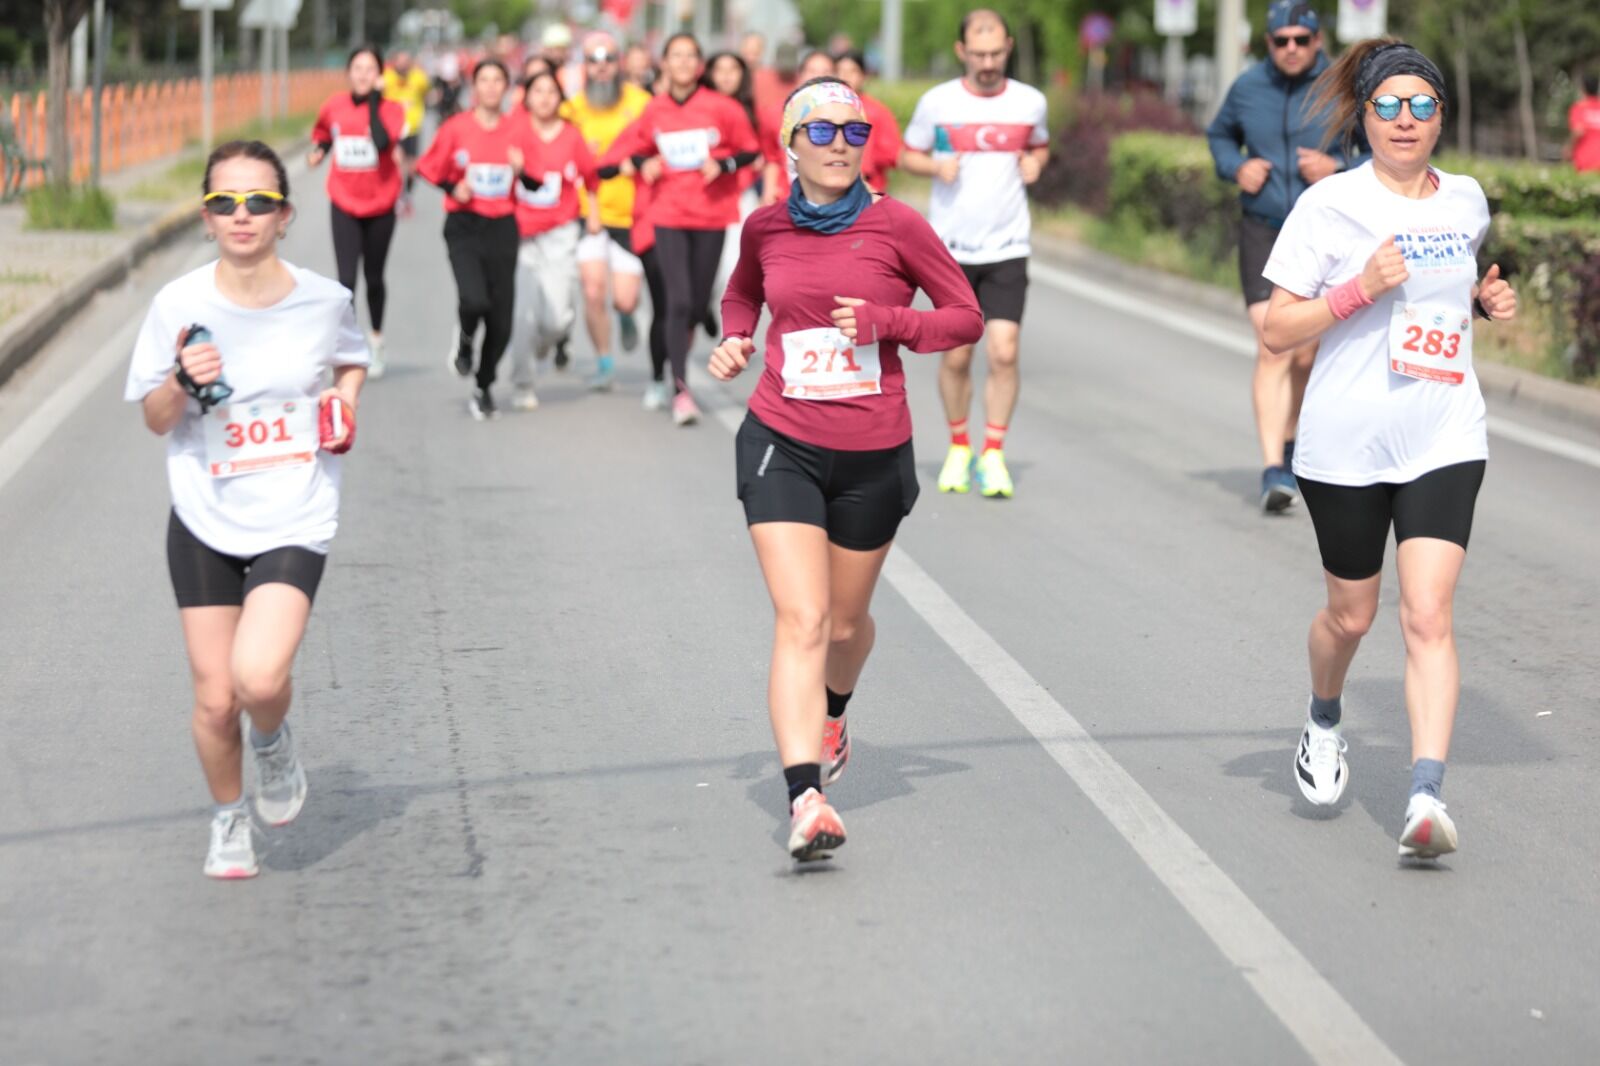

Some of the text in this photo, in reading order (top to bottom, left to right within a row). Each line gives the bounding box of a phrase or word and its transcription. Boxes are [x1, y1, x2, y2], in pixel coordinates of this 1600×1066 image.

[1402, 325, 1461, 359] 283
[800, 347, 862, 374] 271
[224, 417, 293, 448] 301
